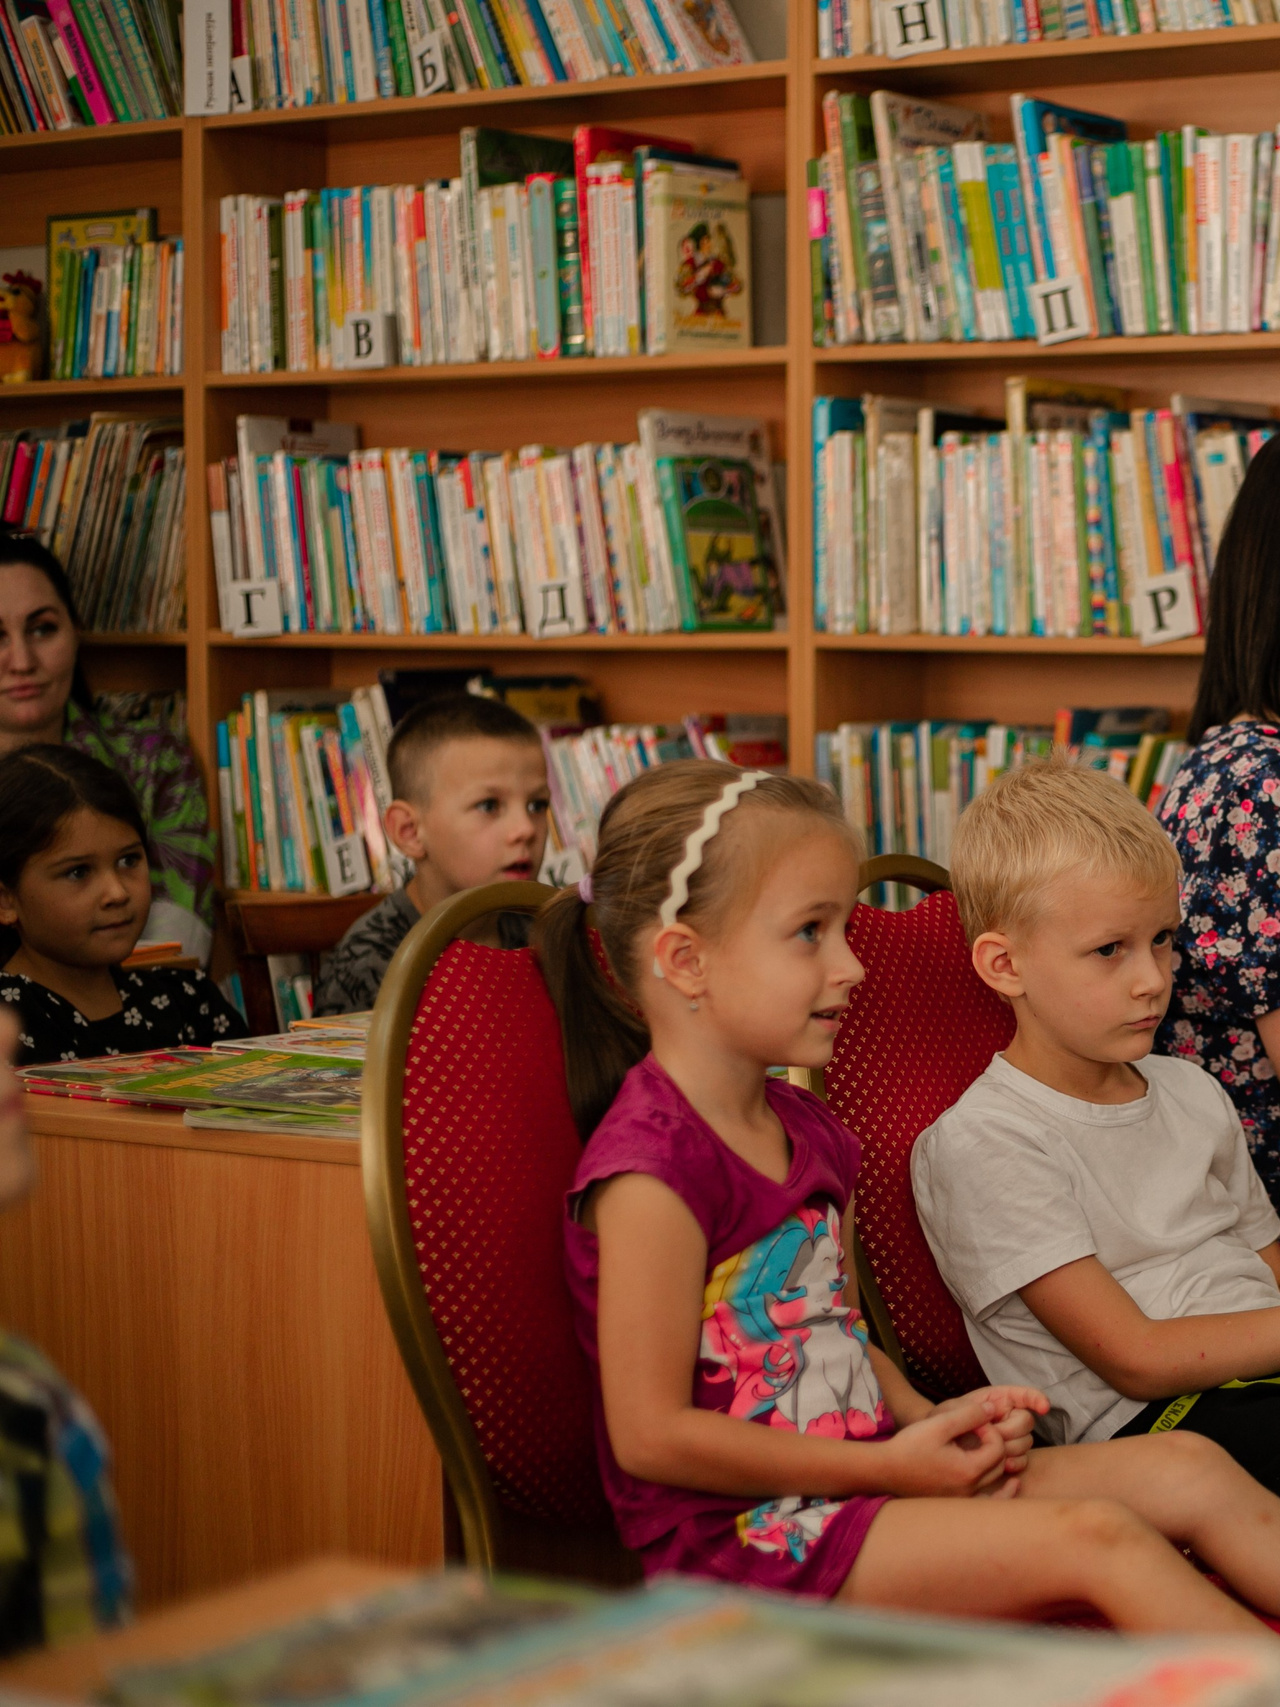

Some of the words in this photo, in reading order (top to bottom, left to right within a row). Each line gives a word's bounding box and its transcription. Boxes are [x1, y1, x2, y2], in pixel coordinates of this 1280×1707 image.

[898, 1, 936, 47] Н
[416, 47, 437, 89] Б
[1038, 287, 1078, 331] П
[351, 319, 374, 359] В
[238, 588, 266, 629] Г
[538, 583, 575, 632] Д
[1146, 586, 1179, 633] Р
[336, 848, 356, 884] Е
